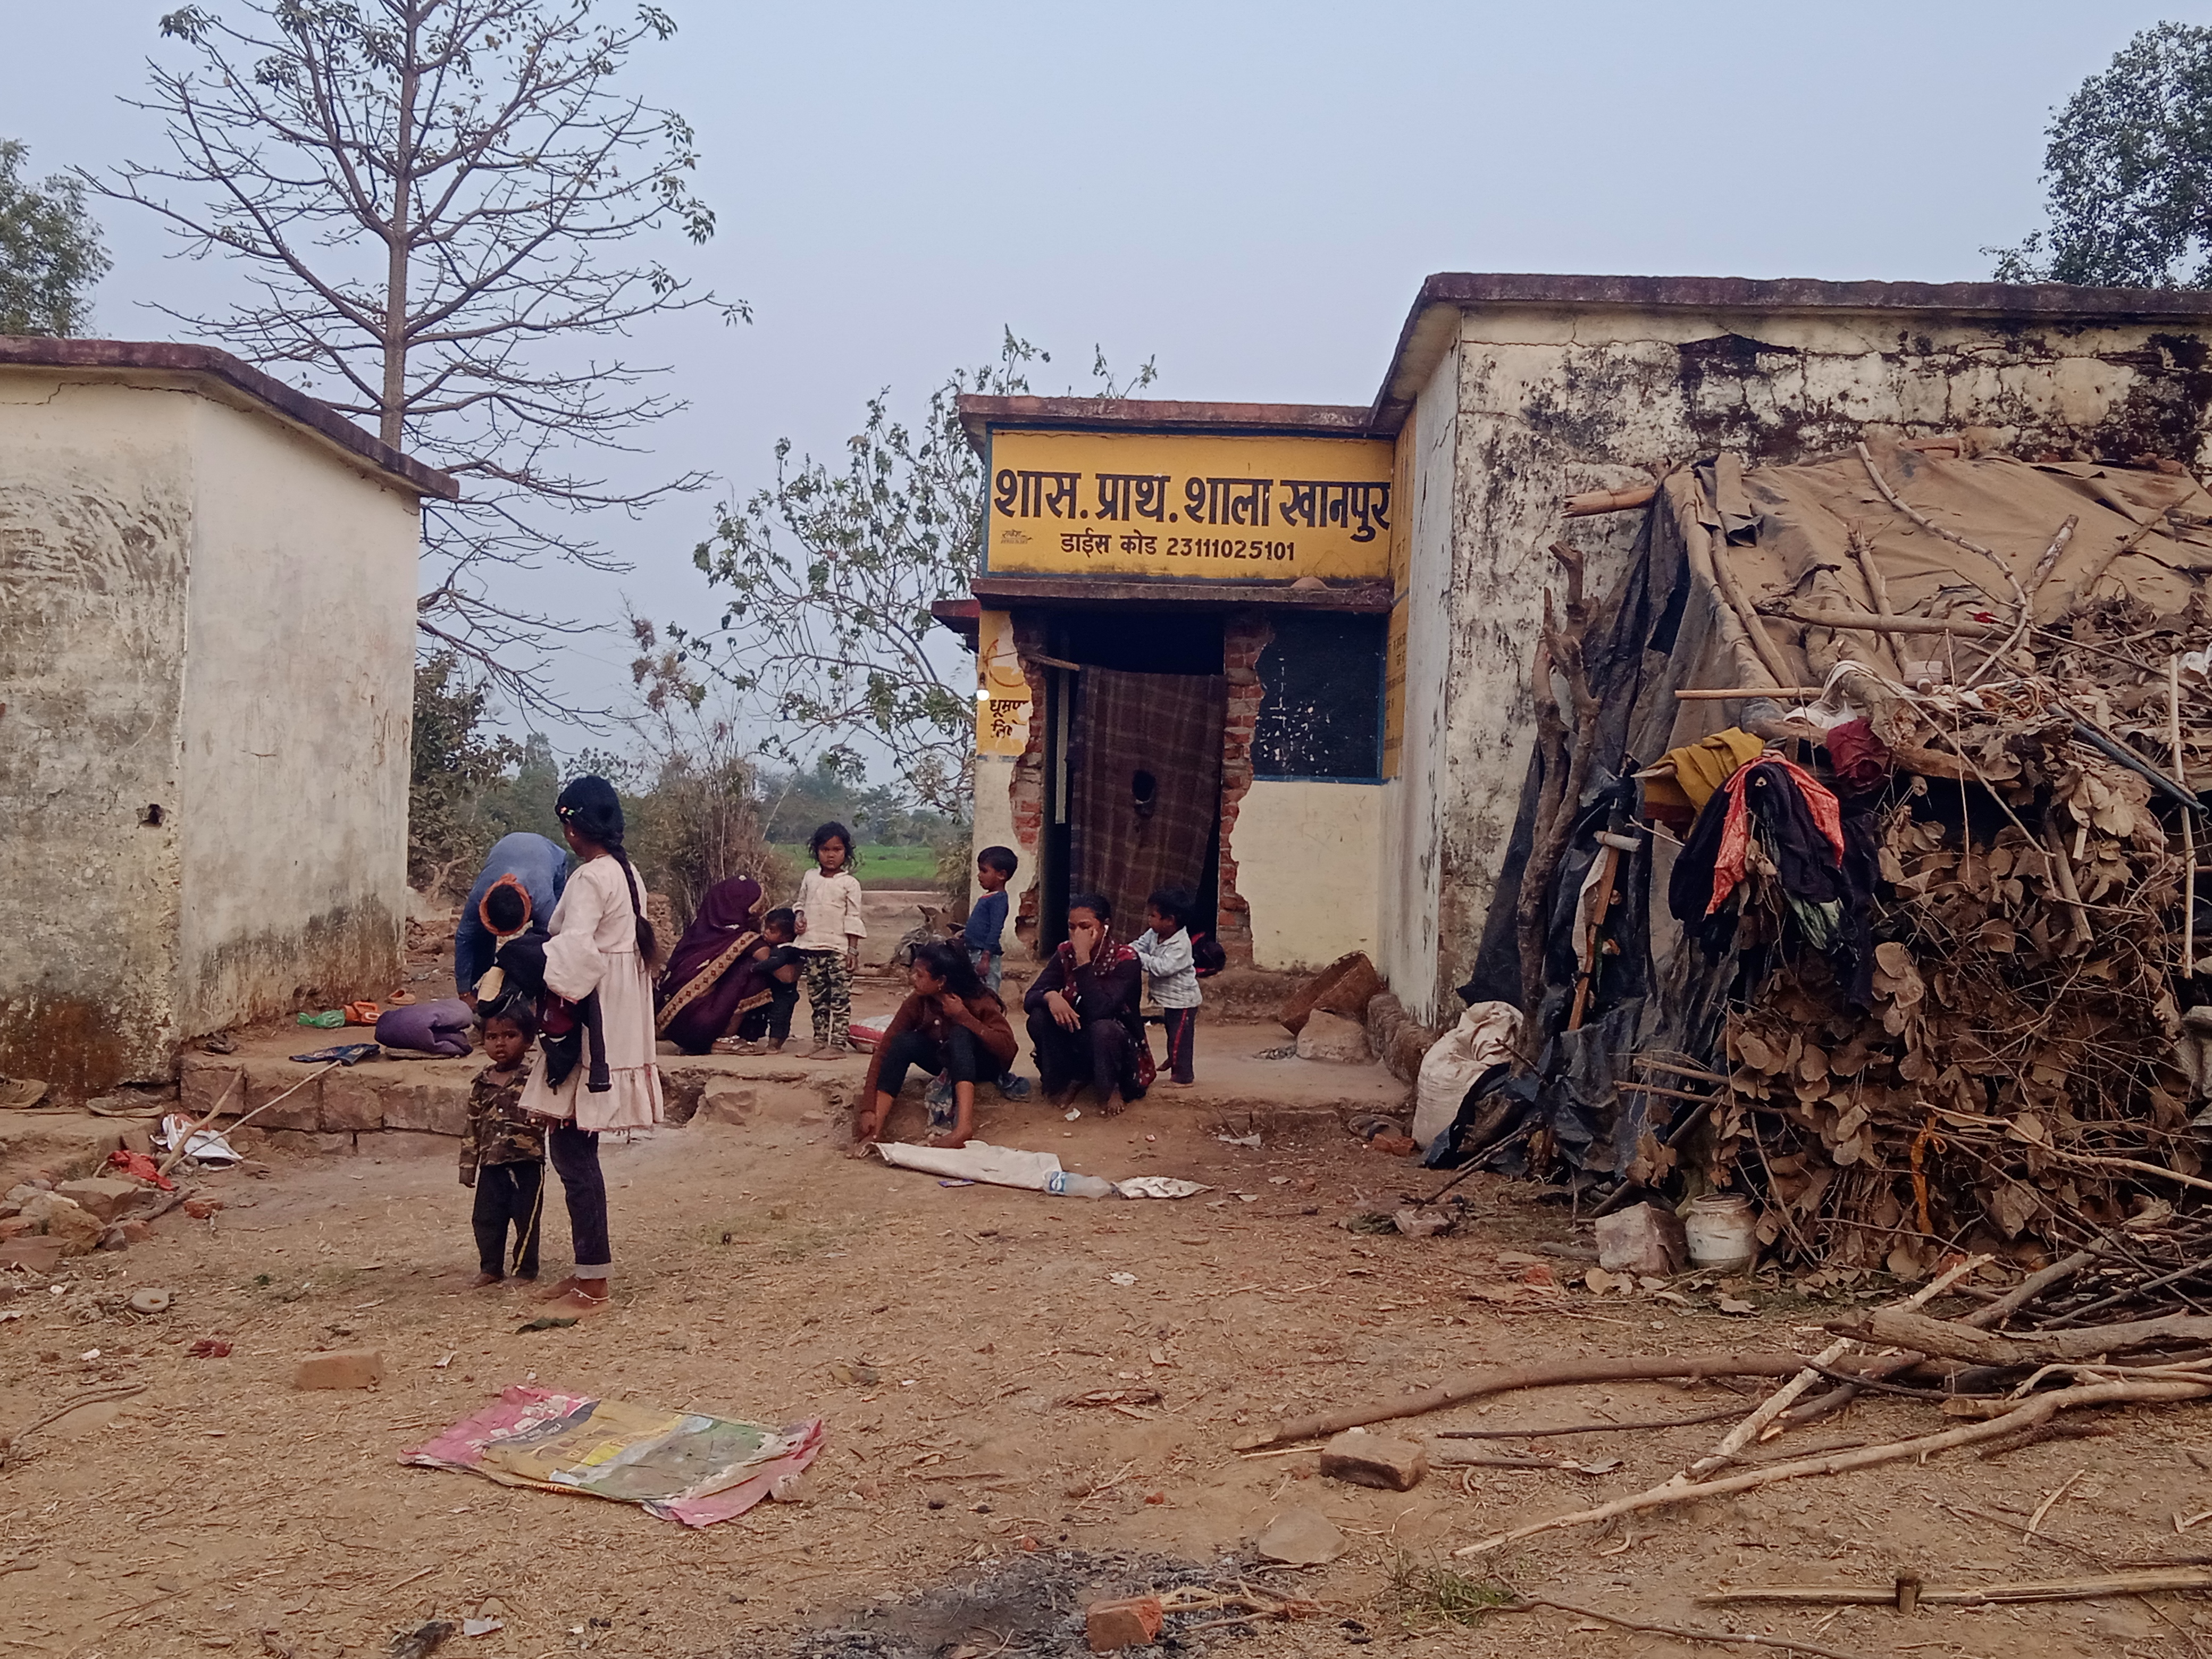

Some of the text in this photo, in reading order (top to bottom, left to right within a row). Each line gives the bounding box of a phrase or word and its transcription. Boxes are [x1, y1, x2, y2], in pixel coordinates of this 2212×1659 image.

[994, 469, 1391, 542] शास. प्राथ. शाला खानपुर
[1060, 527, 1294, 560] डाईस कोड 23111025101
